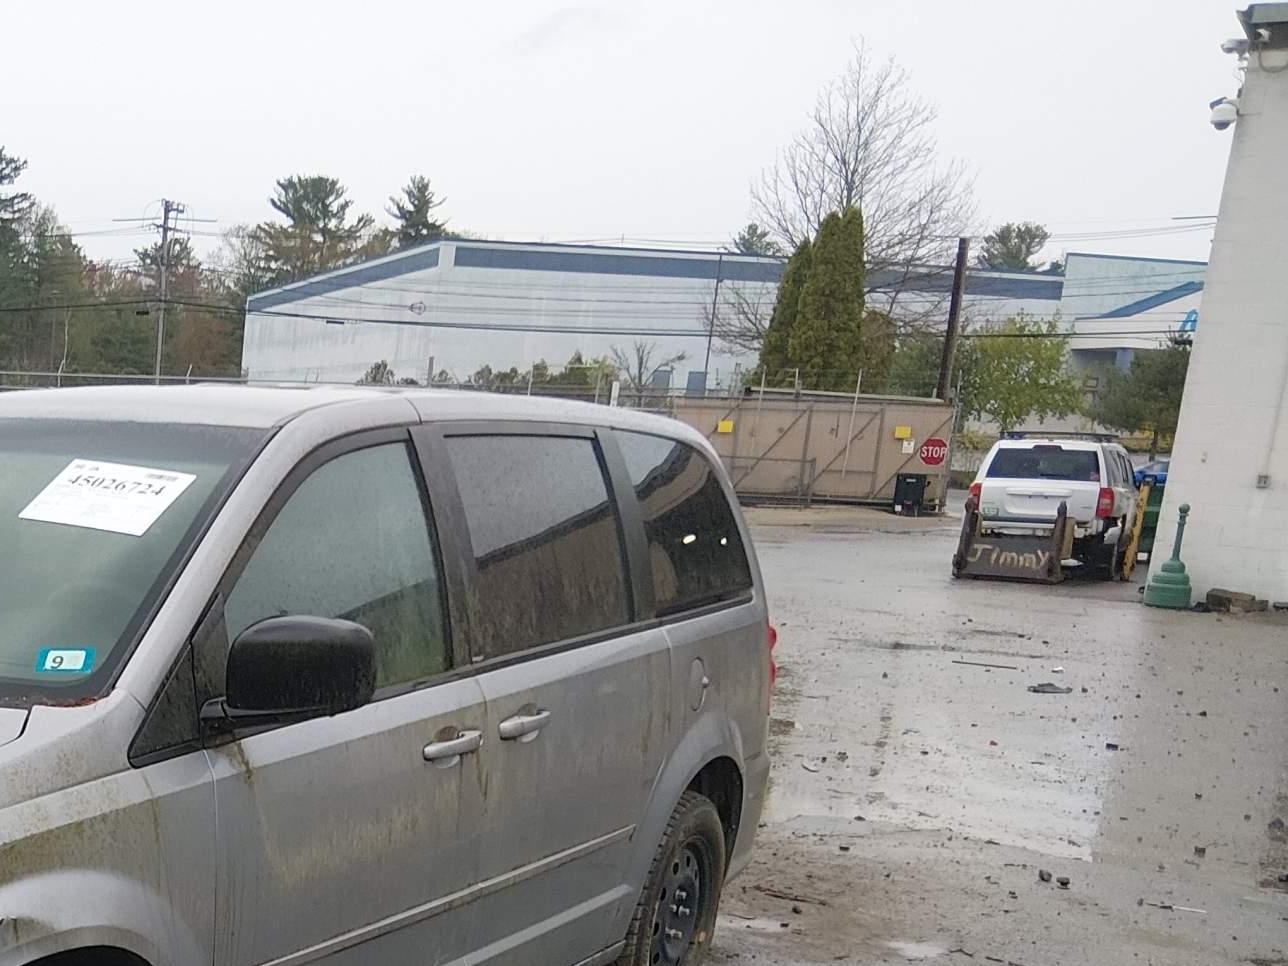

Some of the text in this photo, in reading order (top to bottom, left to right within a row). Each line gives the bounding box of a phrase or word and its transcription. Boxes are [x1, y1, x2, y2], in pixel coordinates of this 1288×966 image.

[921, 446, 948, 458] STOP
[68, 474, 167, 496] 45026724
[50, 655, 64, 669] 9
